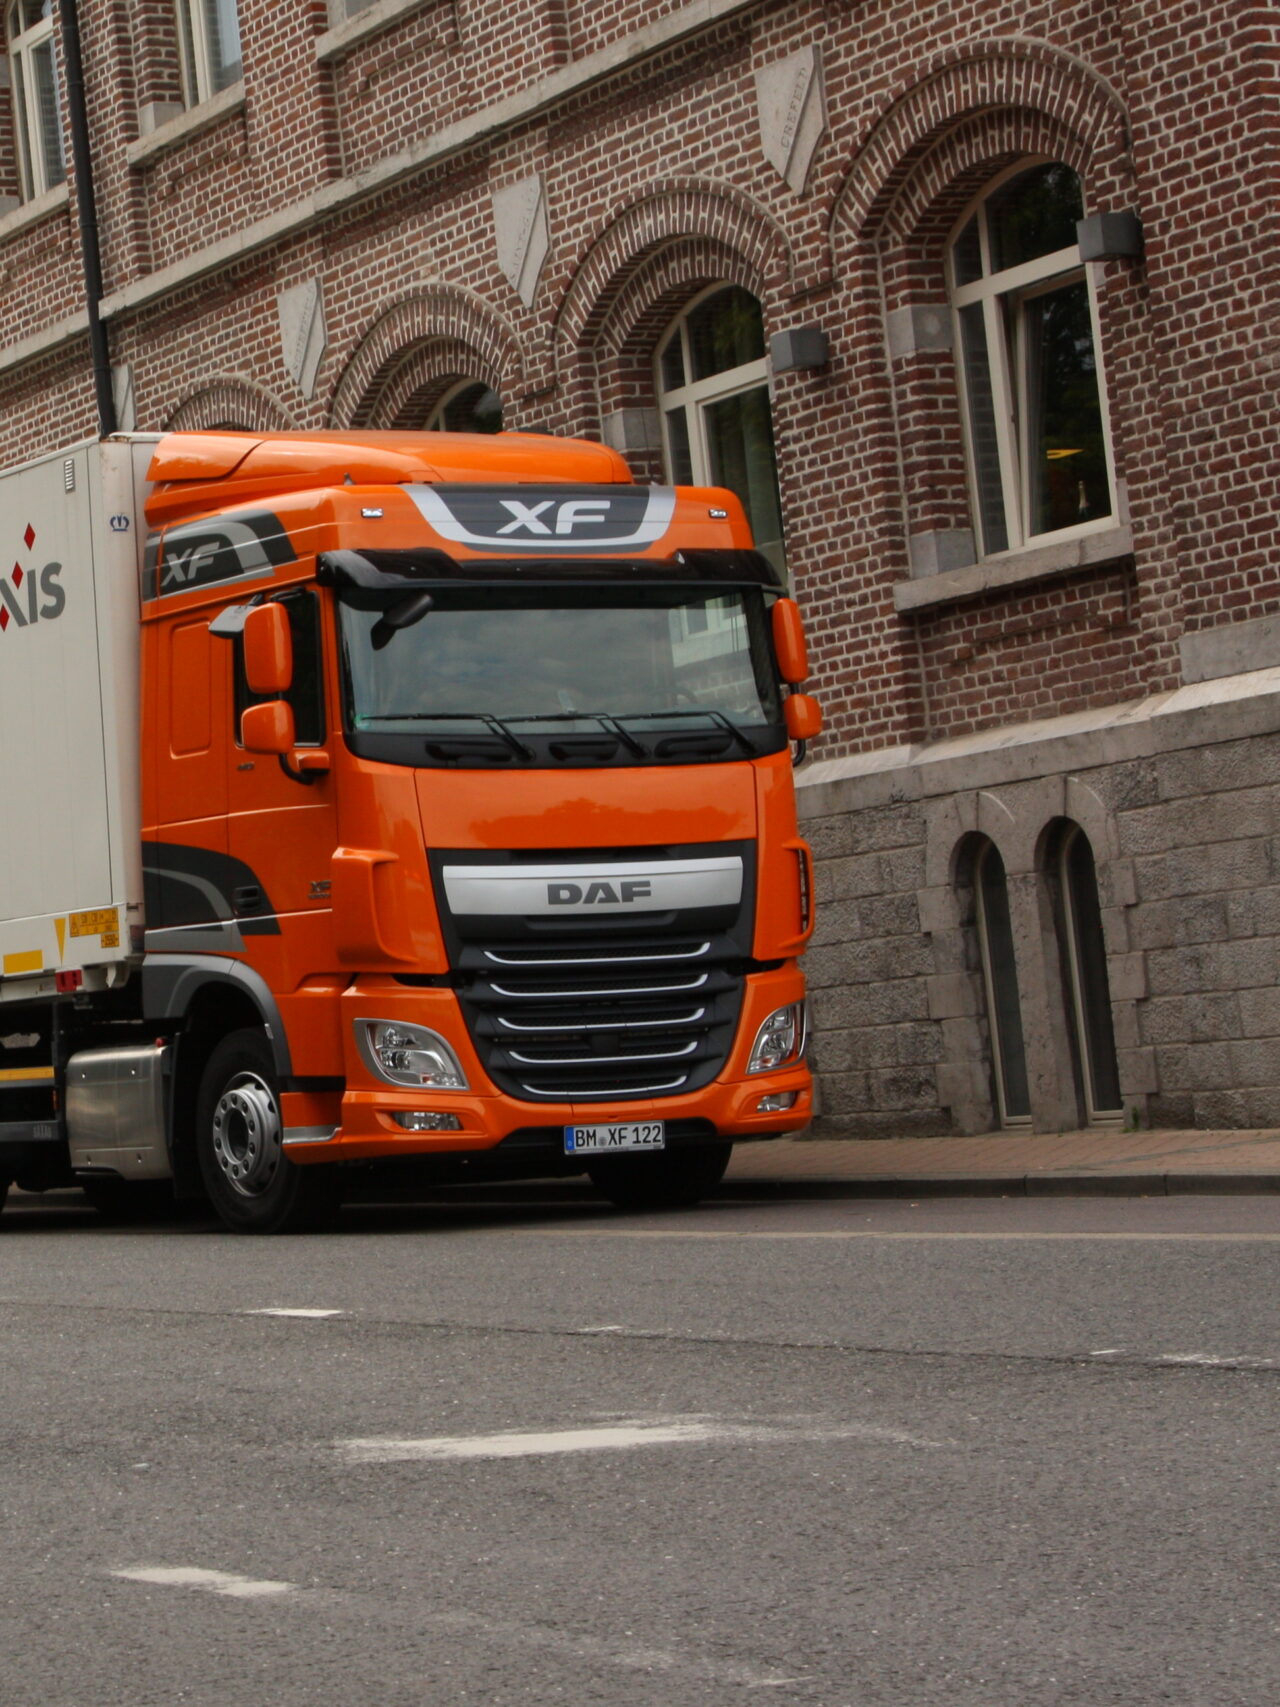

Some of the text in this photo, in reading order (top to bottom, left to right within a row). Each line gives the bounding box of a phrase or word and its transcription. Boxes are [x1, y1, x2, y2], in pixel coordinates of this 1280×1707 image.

[780, 67, 808, 149] CREFELD
[496, 500, 612, 535] XF
[161, 542, 220, 587] XF
[547, 880, 652, 905] DAF
[575, 1125, 661, 1148] BM XF 122
